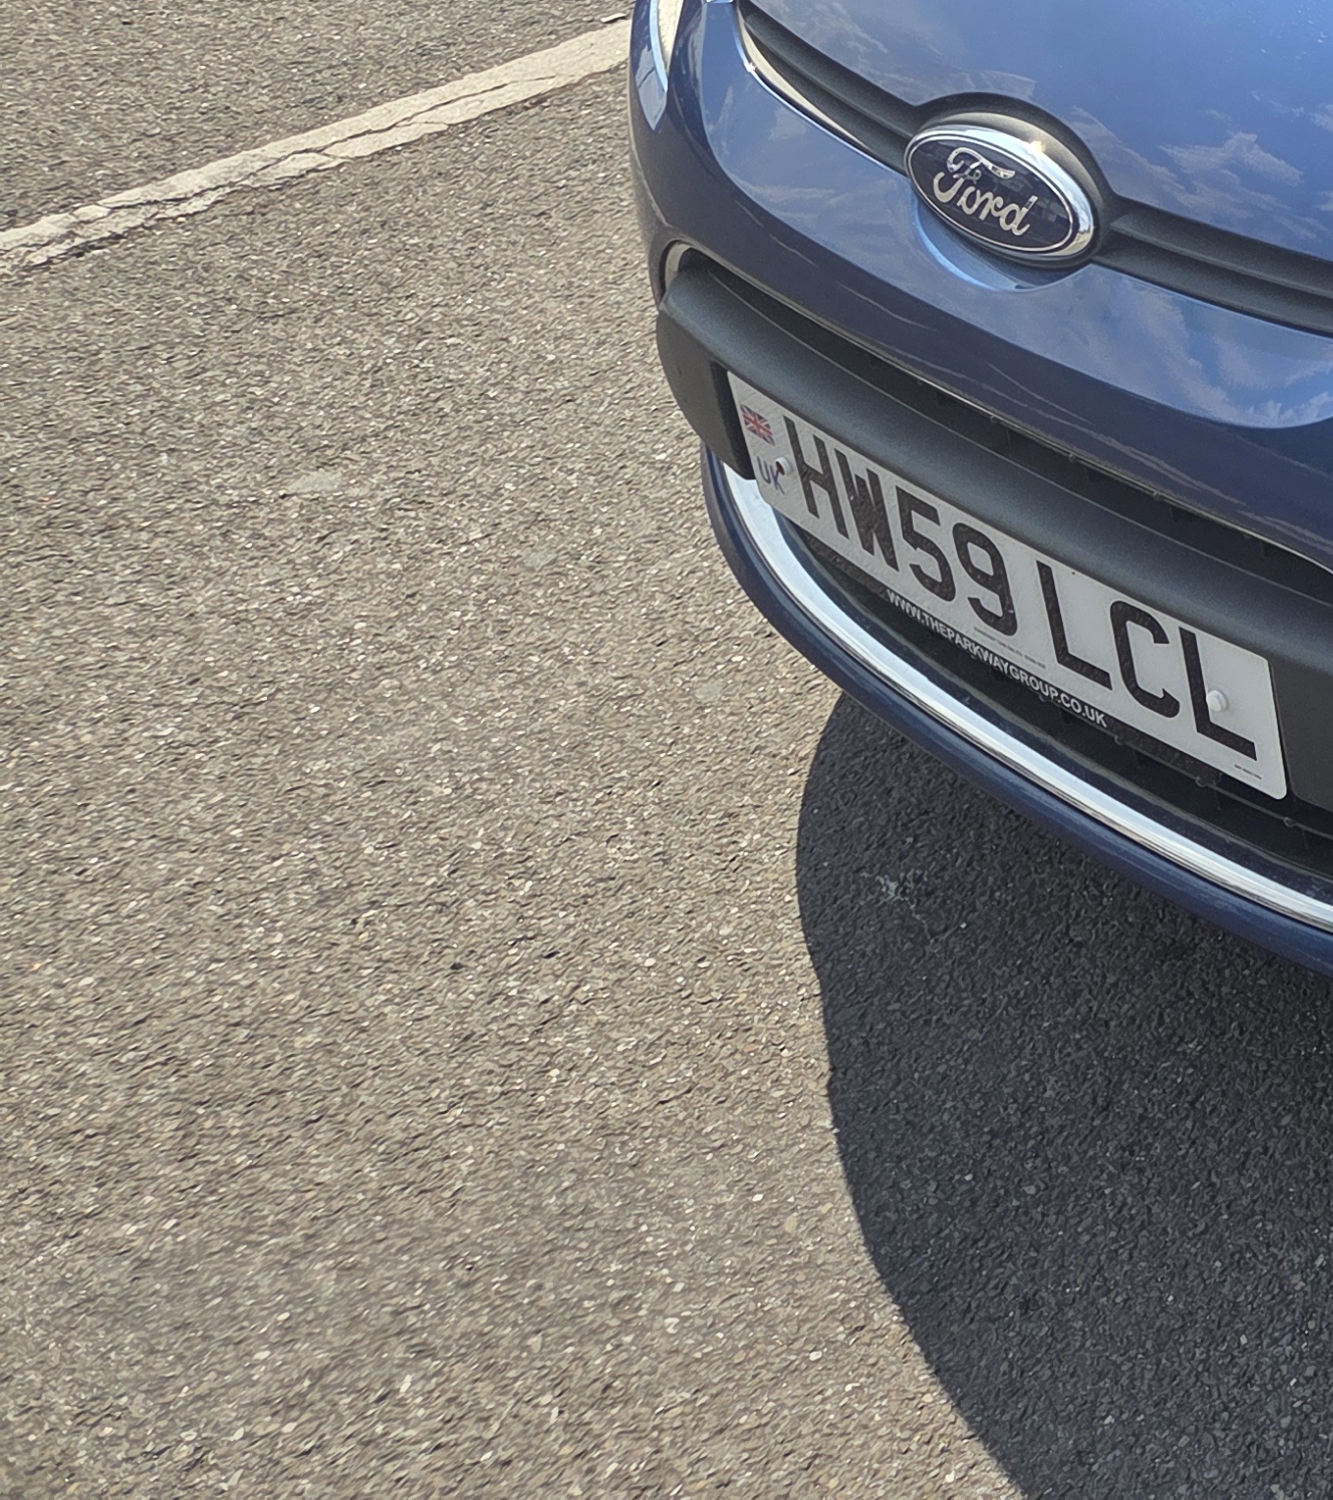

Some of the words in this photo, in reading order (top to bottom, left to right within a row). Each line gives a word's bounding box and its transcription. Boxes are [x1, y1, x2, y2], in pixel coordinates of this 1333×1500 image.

[932, 146, 1039, 236] Ford
[756, 455, 786, 496] UK
[782, 414, 1020, 637] HW59
[1035, 558, 1258, 762] LCL
[886, 588, 1108, 729] WWW.THEPARKWAYGROUP.CO.UK
